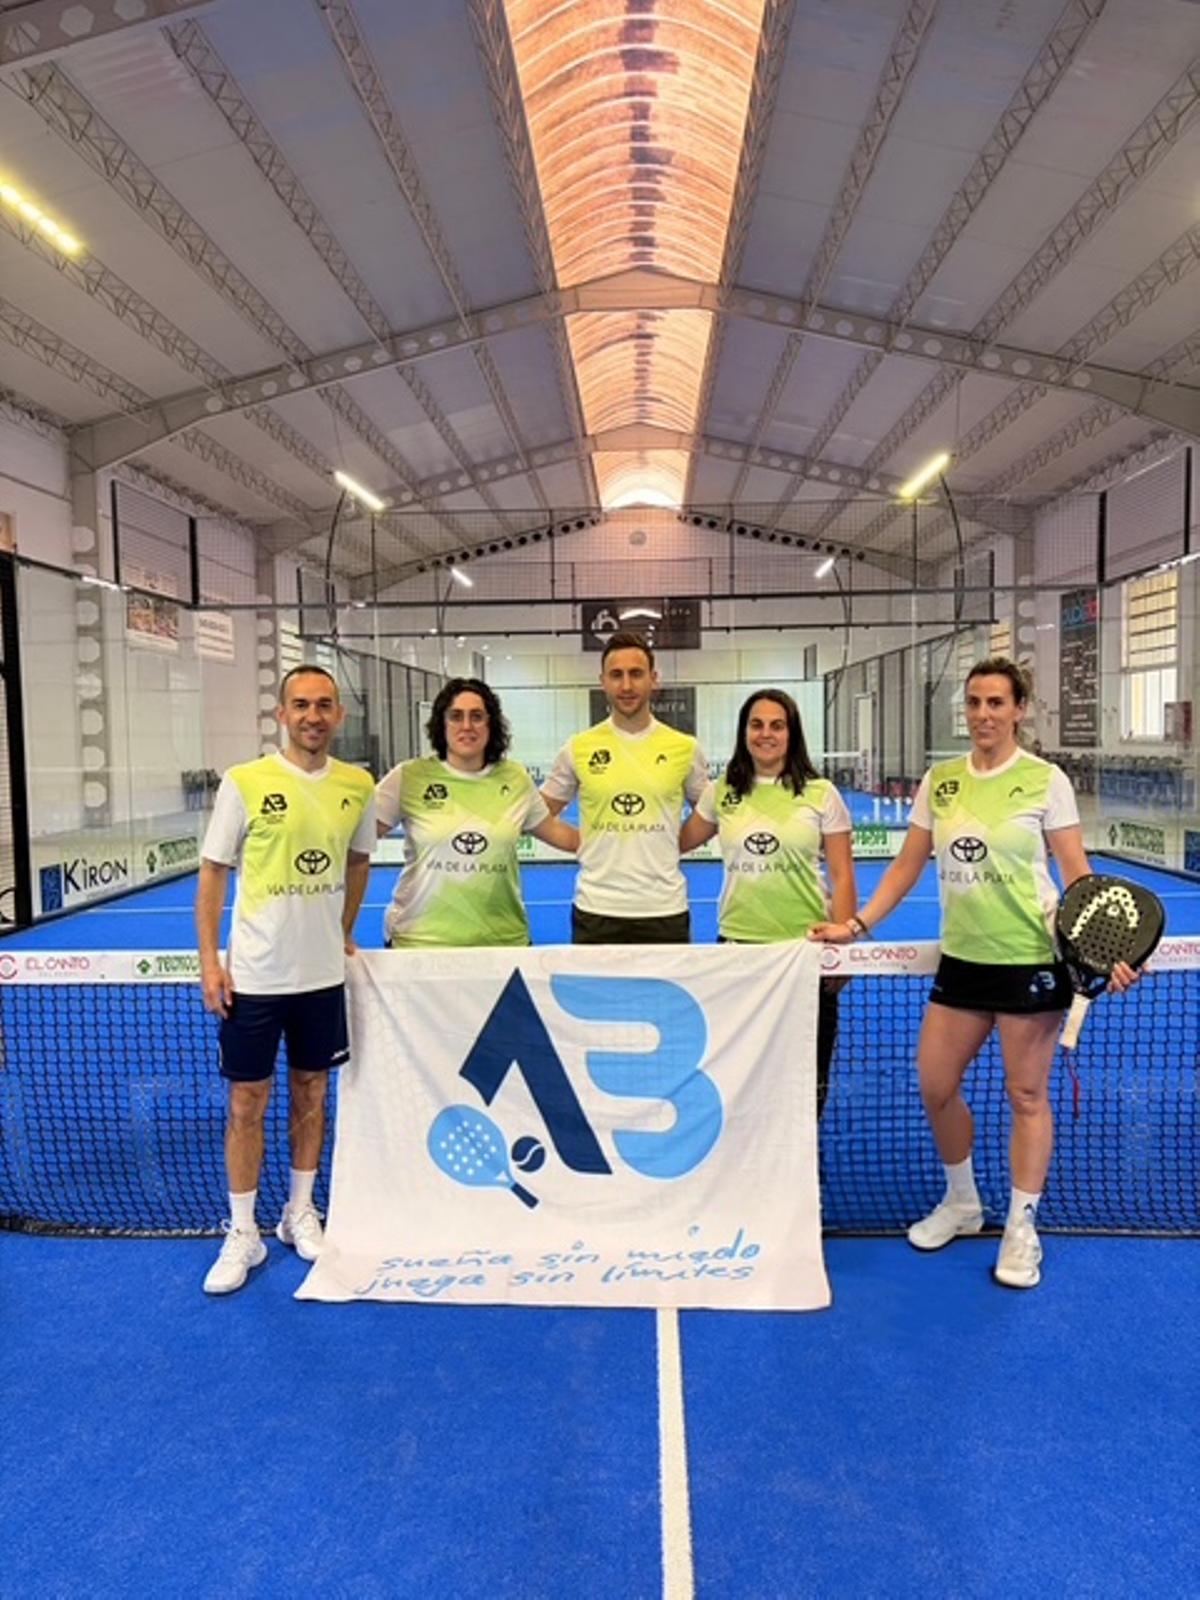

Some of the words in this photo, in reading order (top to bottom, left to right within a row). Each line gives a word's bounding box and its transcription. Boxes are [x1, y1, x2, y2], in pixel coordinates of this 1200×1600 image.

[459, 966, 726, 1182] AB
[379, 1249, 514, 1271] sueña
[536, 1240, 601, 1270] sin
[626, 1225, 762, 1265] miedo
[353, 1269, 488, 1297] juega
[509, 1268, 576, 1288] sin
